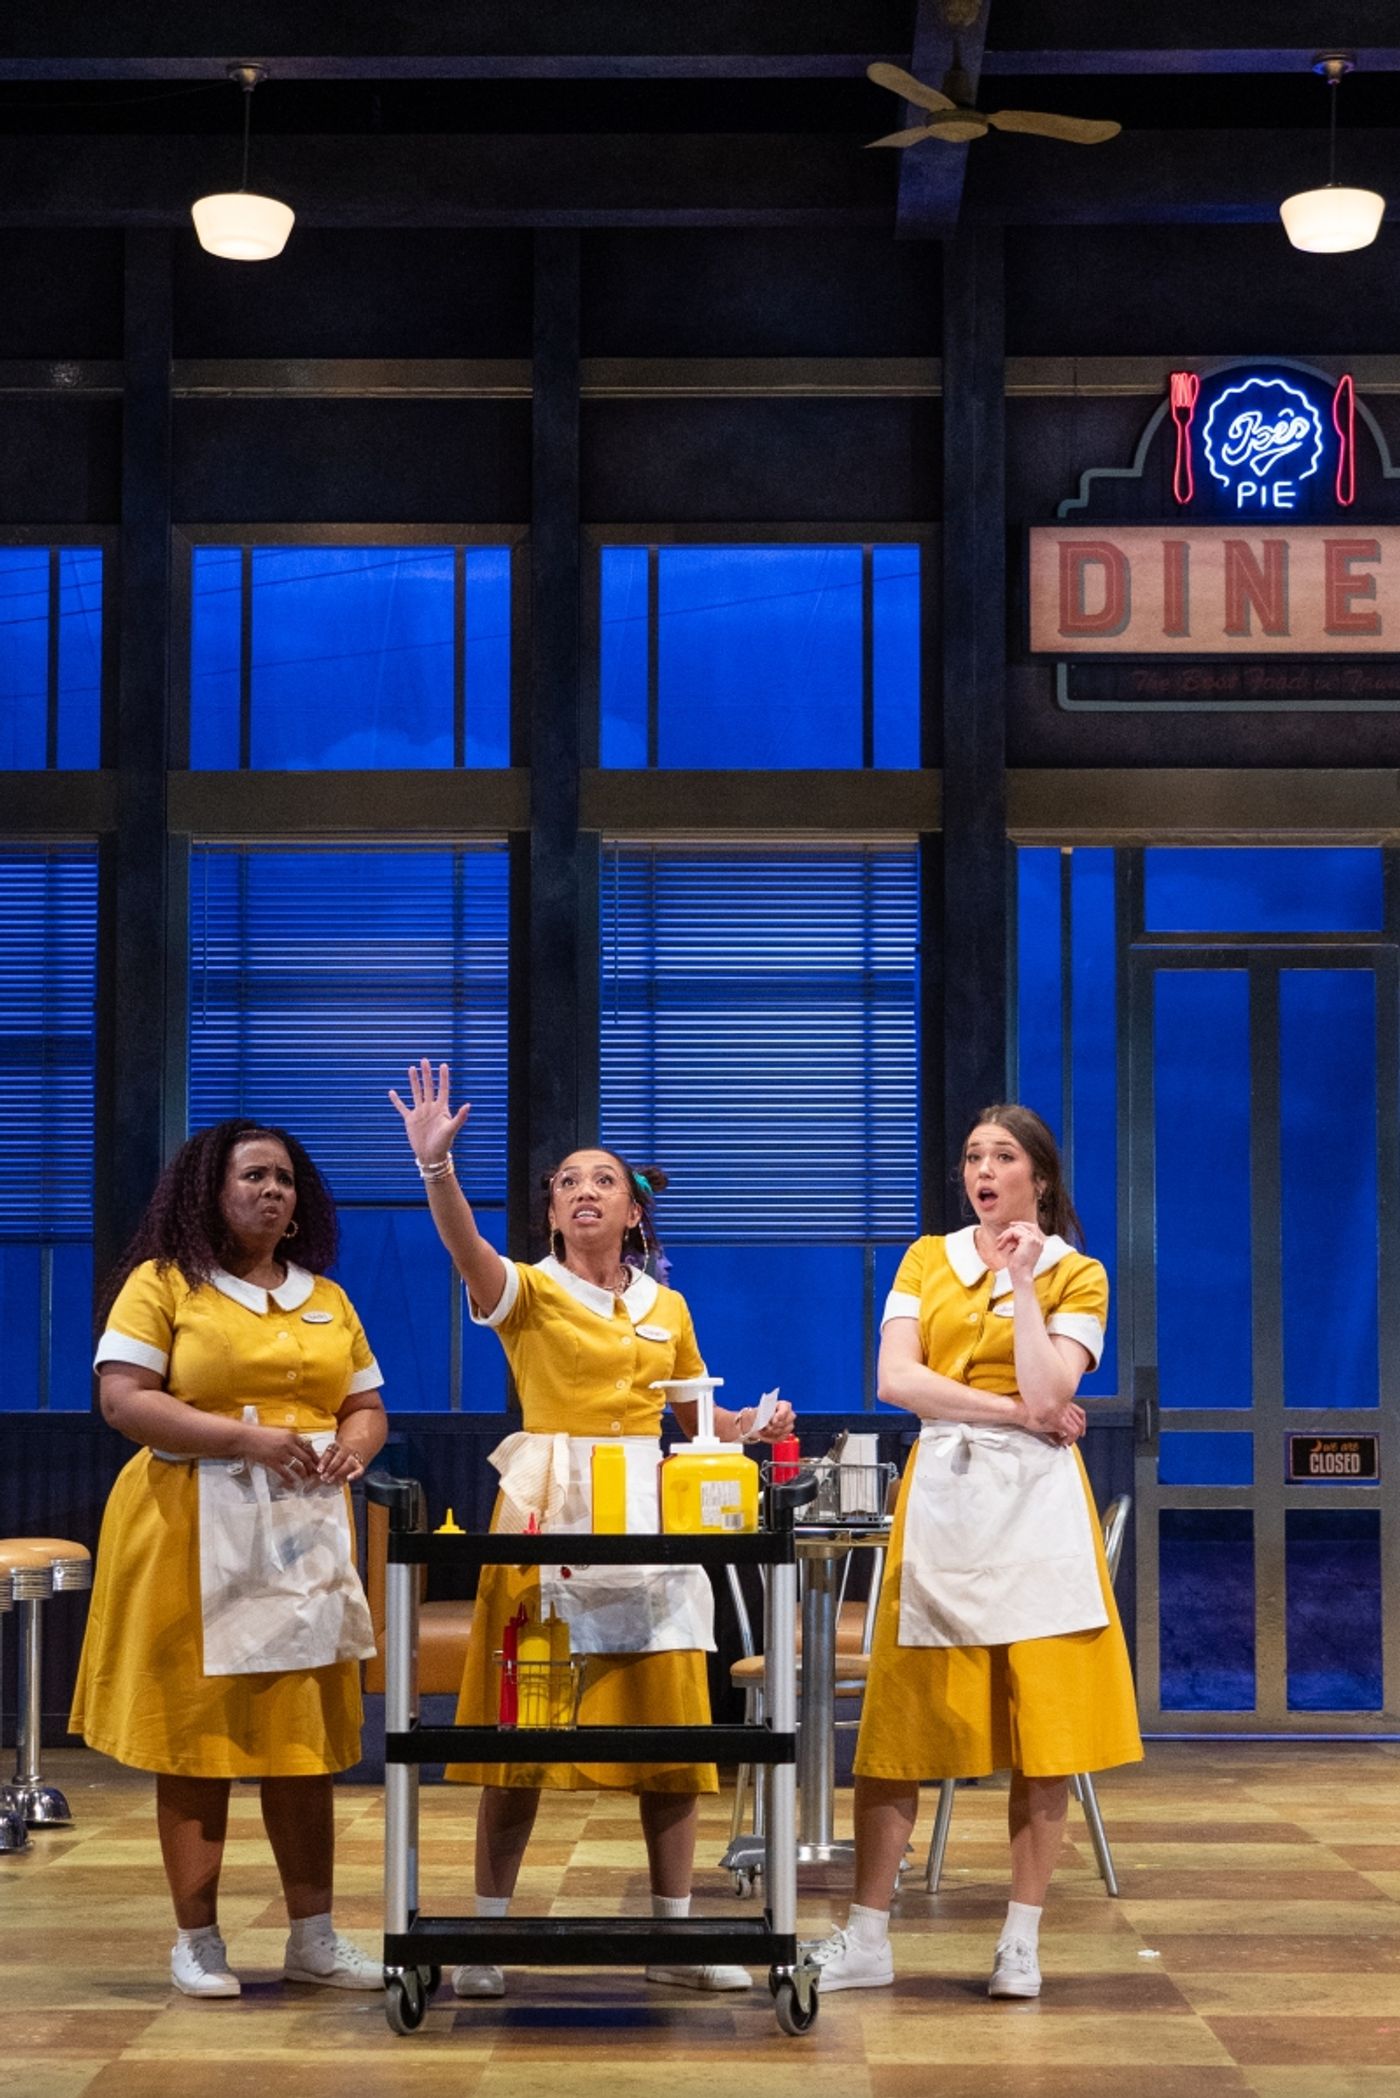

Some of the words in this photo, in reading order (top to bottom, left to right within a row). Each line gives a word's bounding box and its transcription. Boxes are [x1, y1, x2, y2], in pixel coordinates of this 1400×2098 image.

[1237, 481, 1296, 508] PIE
[1057, 539, 1381, 638] DINE
[1309, 1453, 1360, 1473] CLOSED
